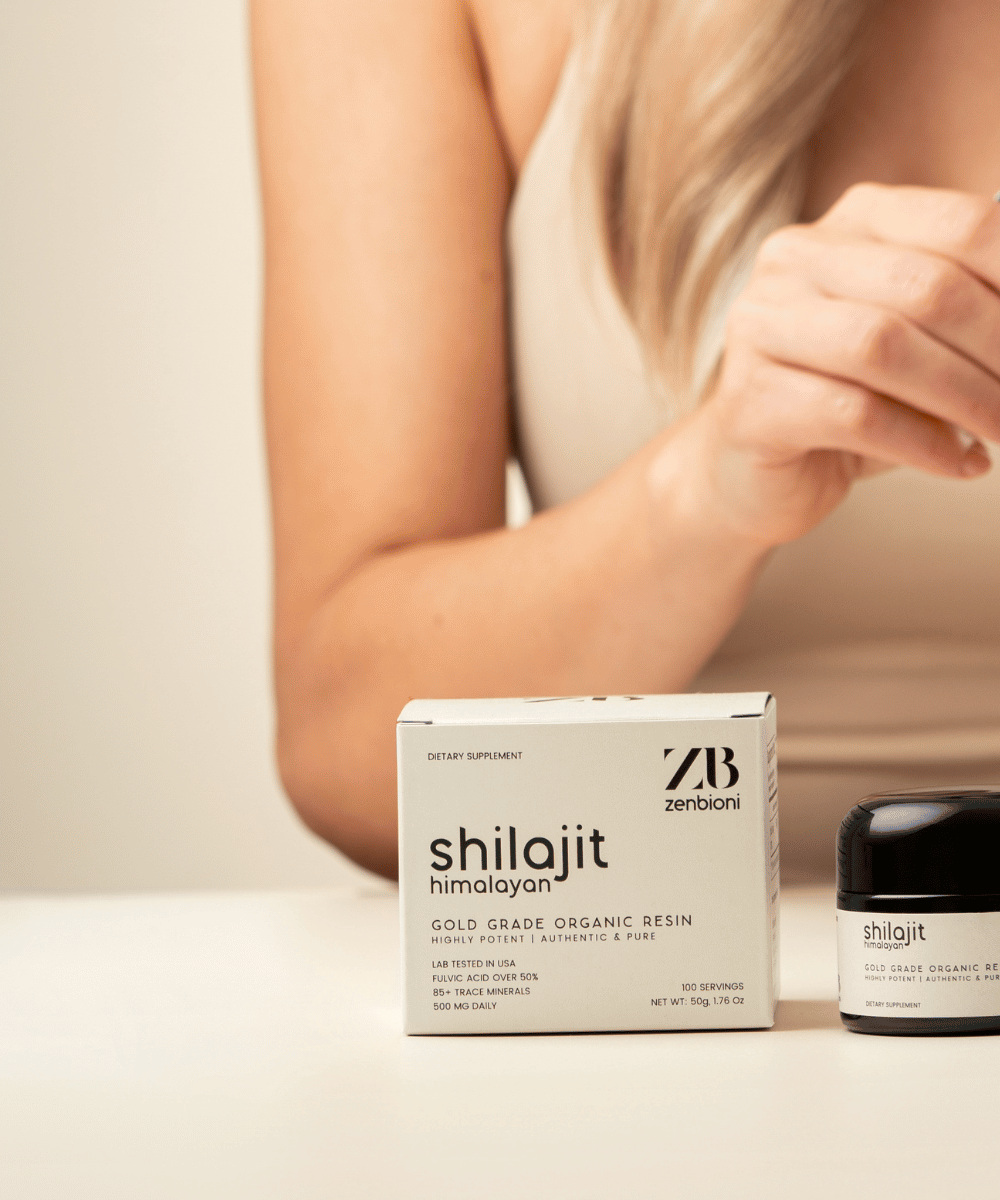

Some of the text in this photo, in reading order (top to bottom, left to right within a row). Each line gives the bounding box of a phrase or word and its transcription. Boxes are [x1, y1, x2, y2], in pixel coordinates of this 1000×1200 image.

[467, 752, 522, 760] SUPPLEMENT
[664, 747, 739, 790] ZB
[665, 793, 740, 811] zenbioni
[430, 824, 608, 883] shilajit
[431, 875, 550, 898] himalayan
[432, 915, 691, 930] GOLD GRADE ORGANIC RESIN
[432, 936, 473, 944] HIGHLY
[480, 935, 524, 943] POTENT
[541, 934, 606, 942] AUTHENTIC
[627, 932, 654, 940] PURE
[864, 921, 926, 947] shilajit
[864, 941, 904, 951] himalayan
[452, 960, 483, 968] TESTED
[865, 964, 885, 973] GOLD
[891, 965, 922, 973] GRADE
[929, 964, 978, 973] ORGANIC
[520, 973, 538, 981] 50%
[433, 987, 530, 996] 85+ TRACE MINERALS
[682, 982, 744, 991] 100 SERVINGS
[472, 1002, 496, 1010] DAILY
[651, 998, 667, 1006] NET
[714, 996, 730, 1004] 1.76
